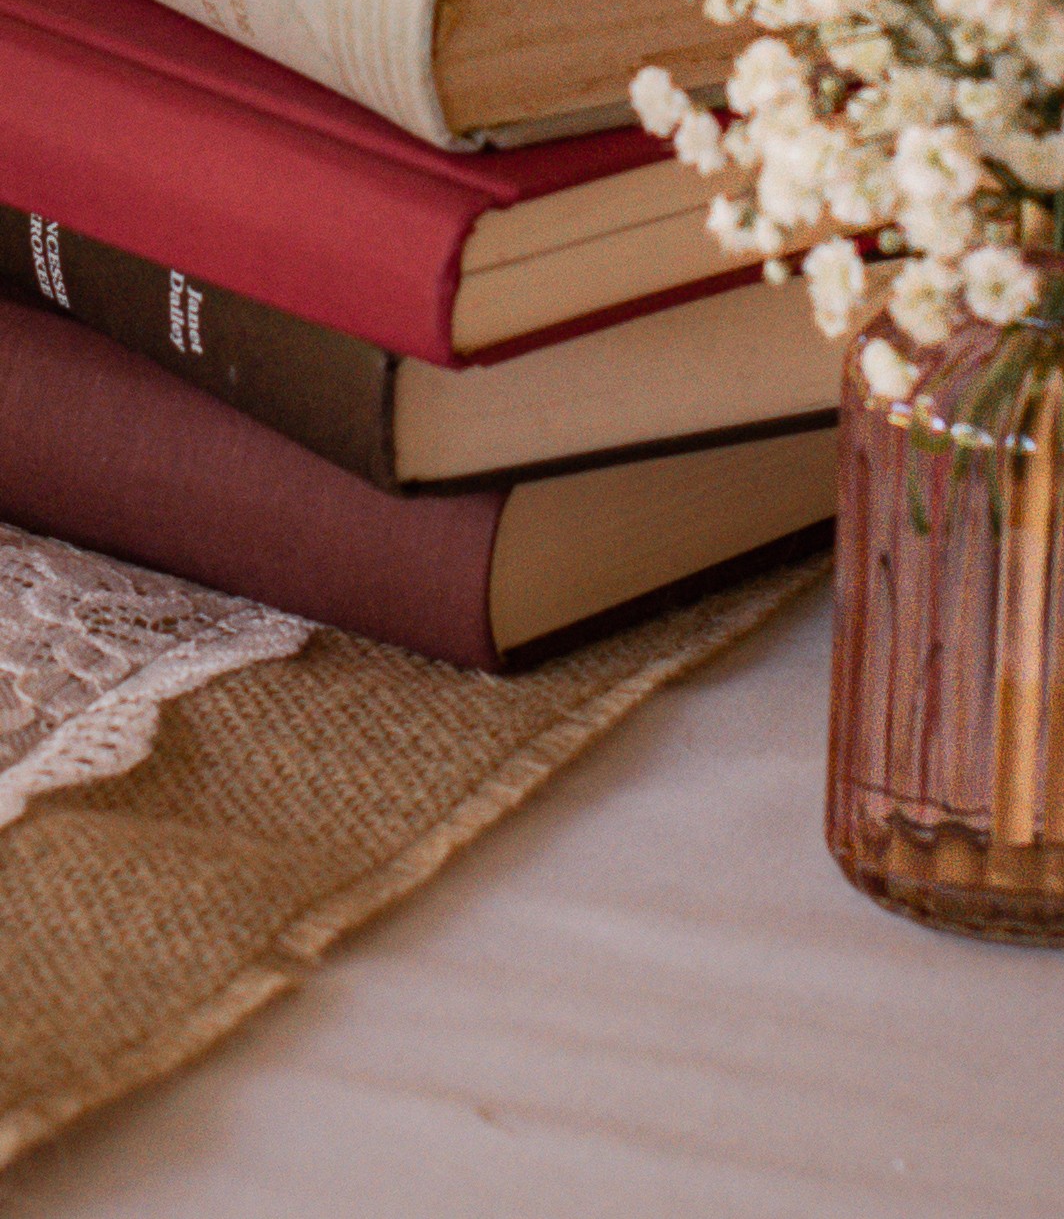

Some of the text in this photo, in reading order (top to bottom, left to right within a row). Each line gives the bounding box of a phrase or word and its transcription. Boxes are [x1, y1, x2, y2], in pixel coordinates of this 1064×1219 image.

[29, 211, 55, 300] EROKEE
[46, 220, 71, 309] NCESSE
[168, 268, 187, 354] Dailey
[186, 284, 204, 355] Janet
